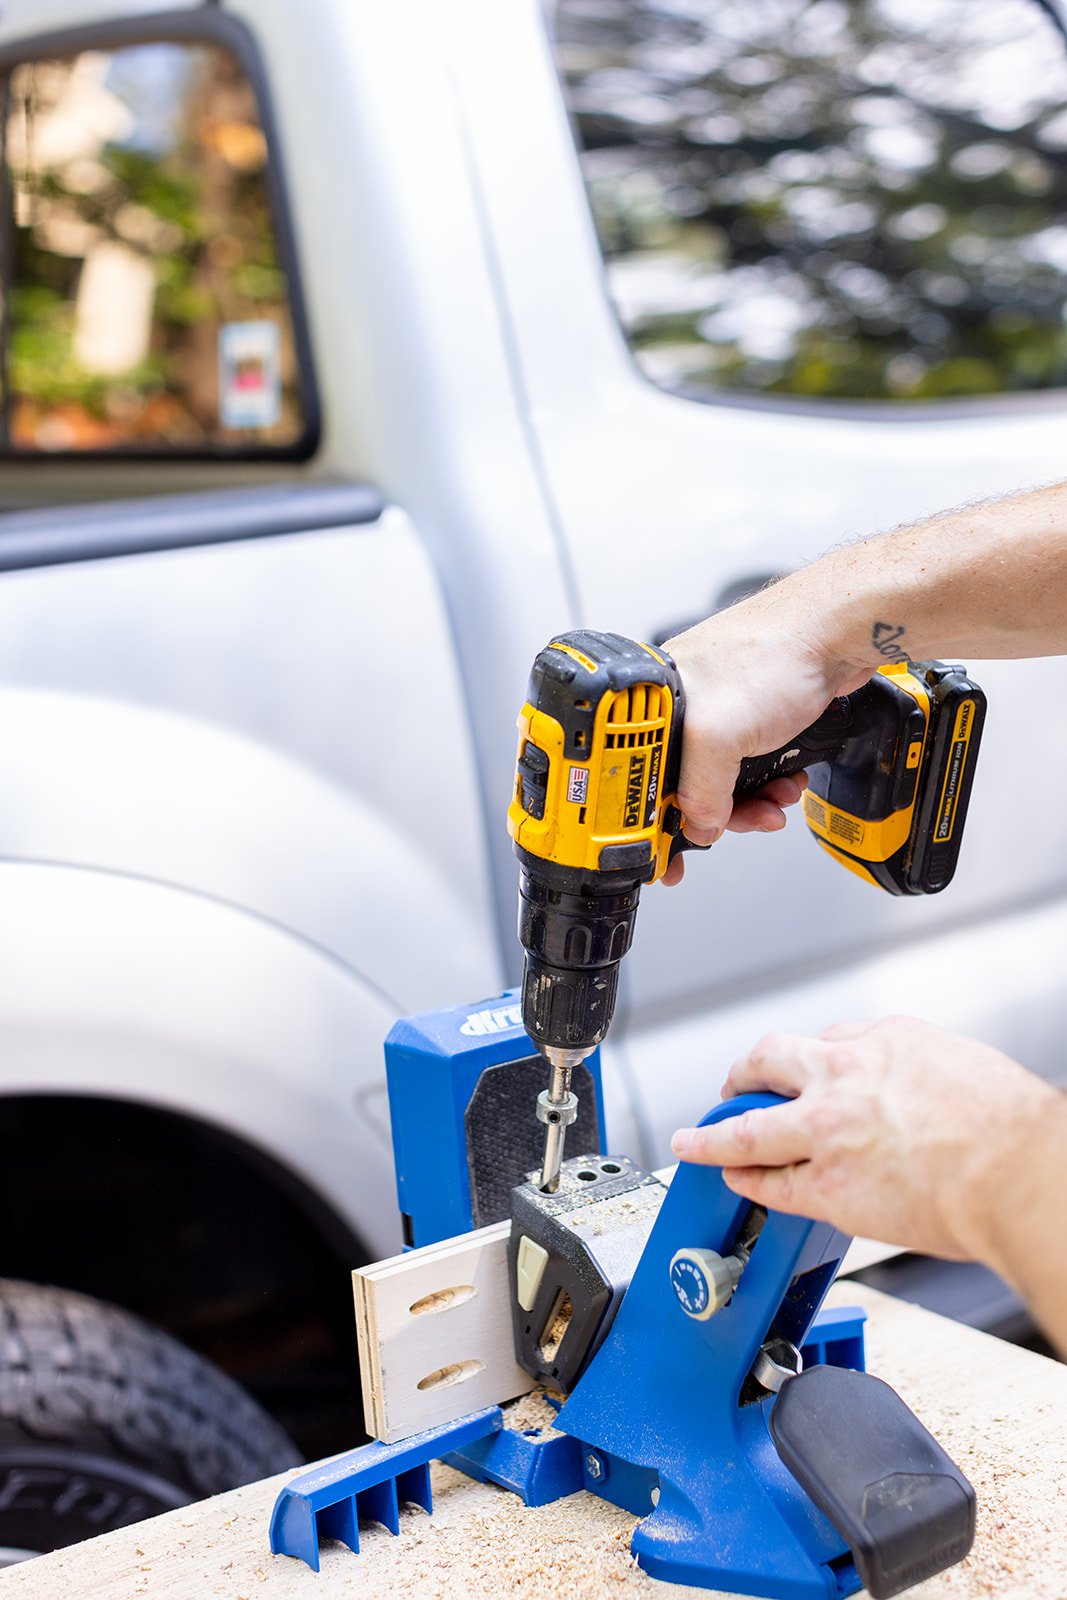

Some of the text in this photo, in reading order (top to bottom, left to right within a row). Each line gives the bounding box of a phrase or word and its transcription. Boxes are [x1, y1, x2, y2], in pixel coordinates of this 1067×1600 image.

[653, 751, 661, 775] MAX
[948, 759, 960, 795] LITHIUM
[955, 742, 963, 759] ION
[572, 780, 584, 802] USA
[625, 754, 645, 828] DEWALT
